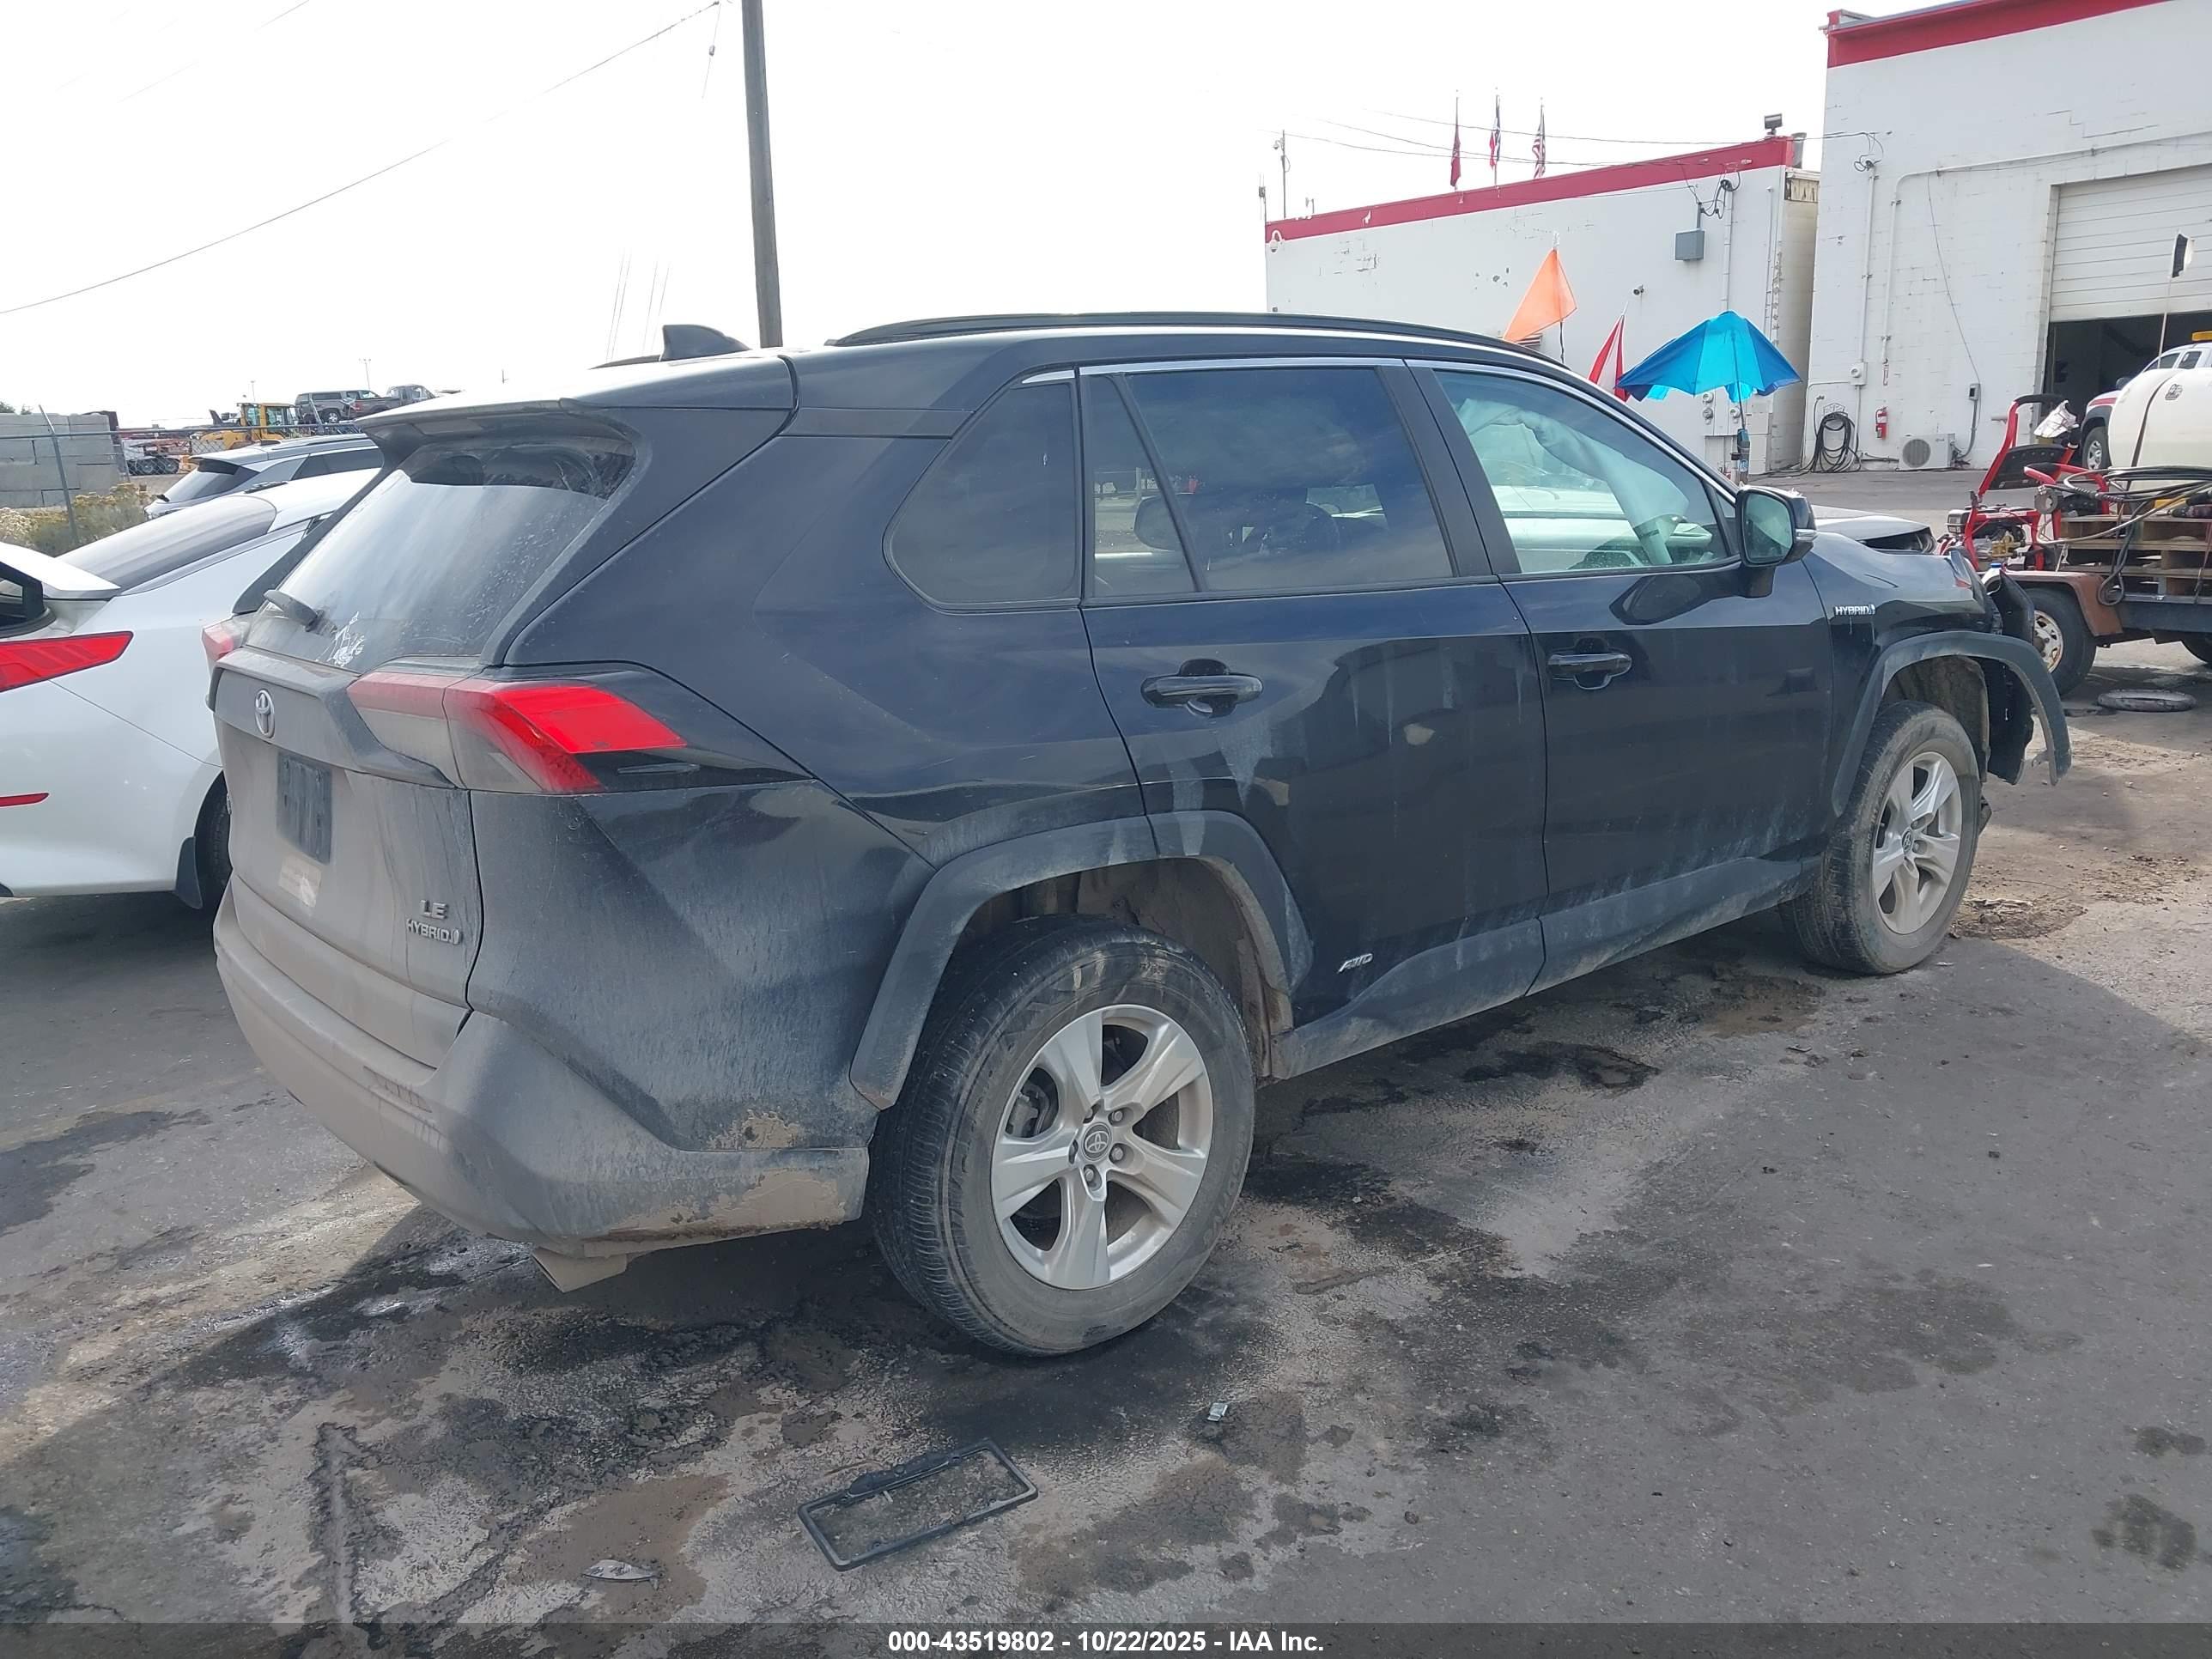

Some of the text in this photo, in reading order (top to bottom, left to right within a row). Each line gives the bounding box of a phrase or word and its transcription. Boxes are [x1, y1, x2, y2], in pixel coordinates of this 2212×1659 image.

[1835, 605, 1870, 616] HYBRID
[420, 899, 448, 920] LE
[406, 918, 451, 943] HYBRID
